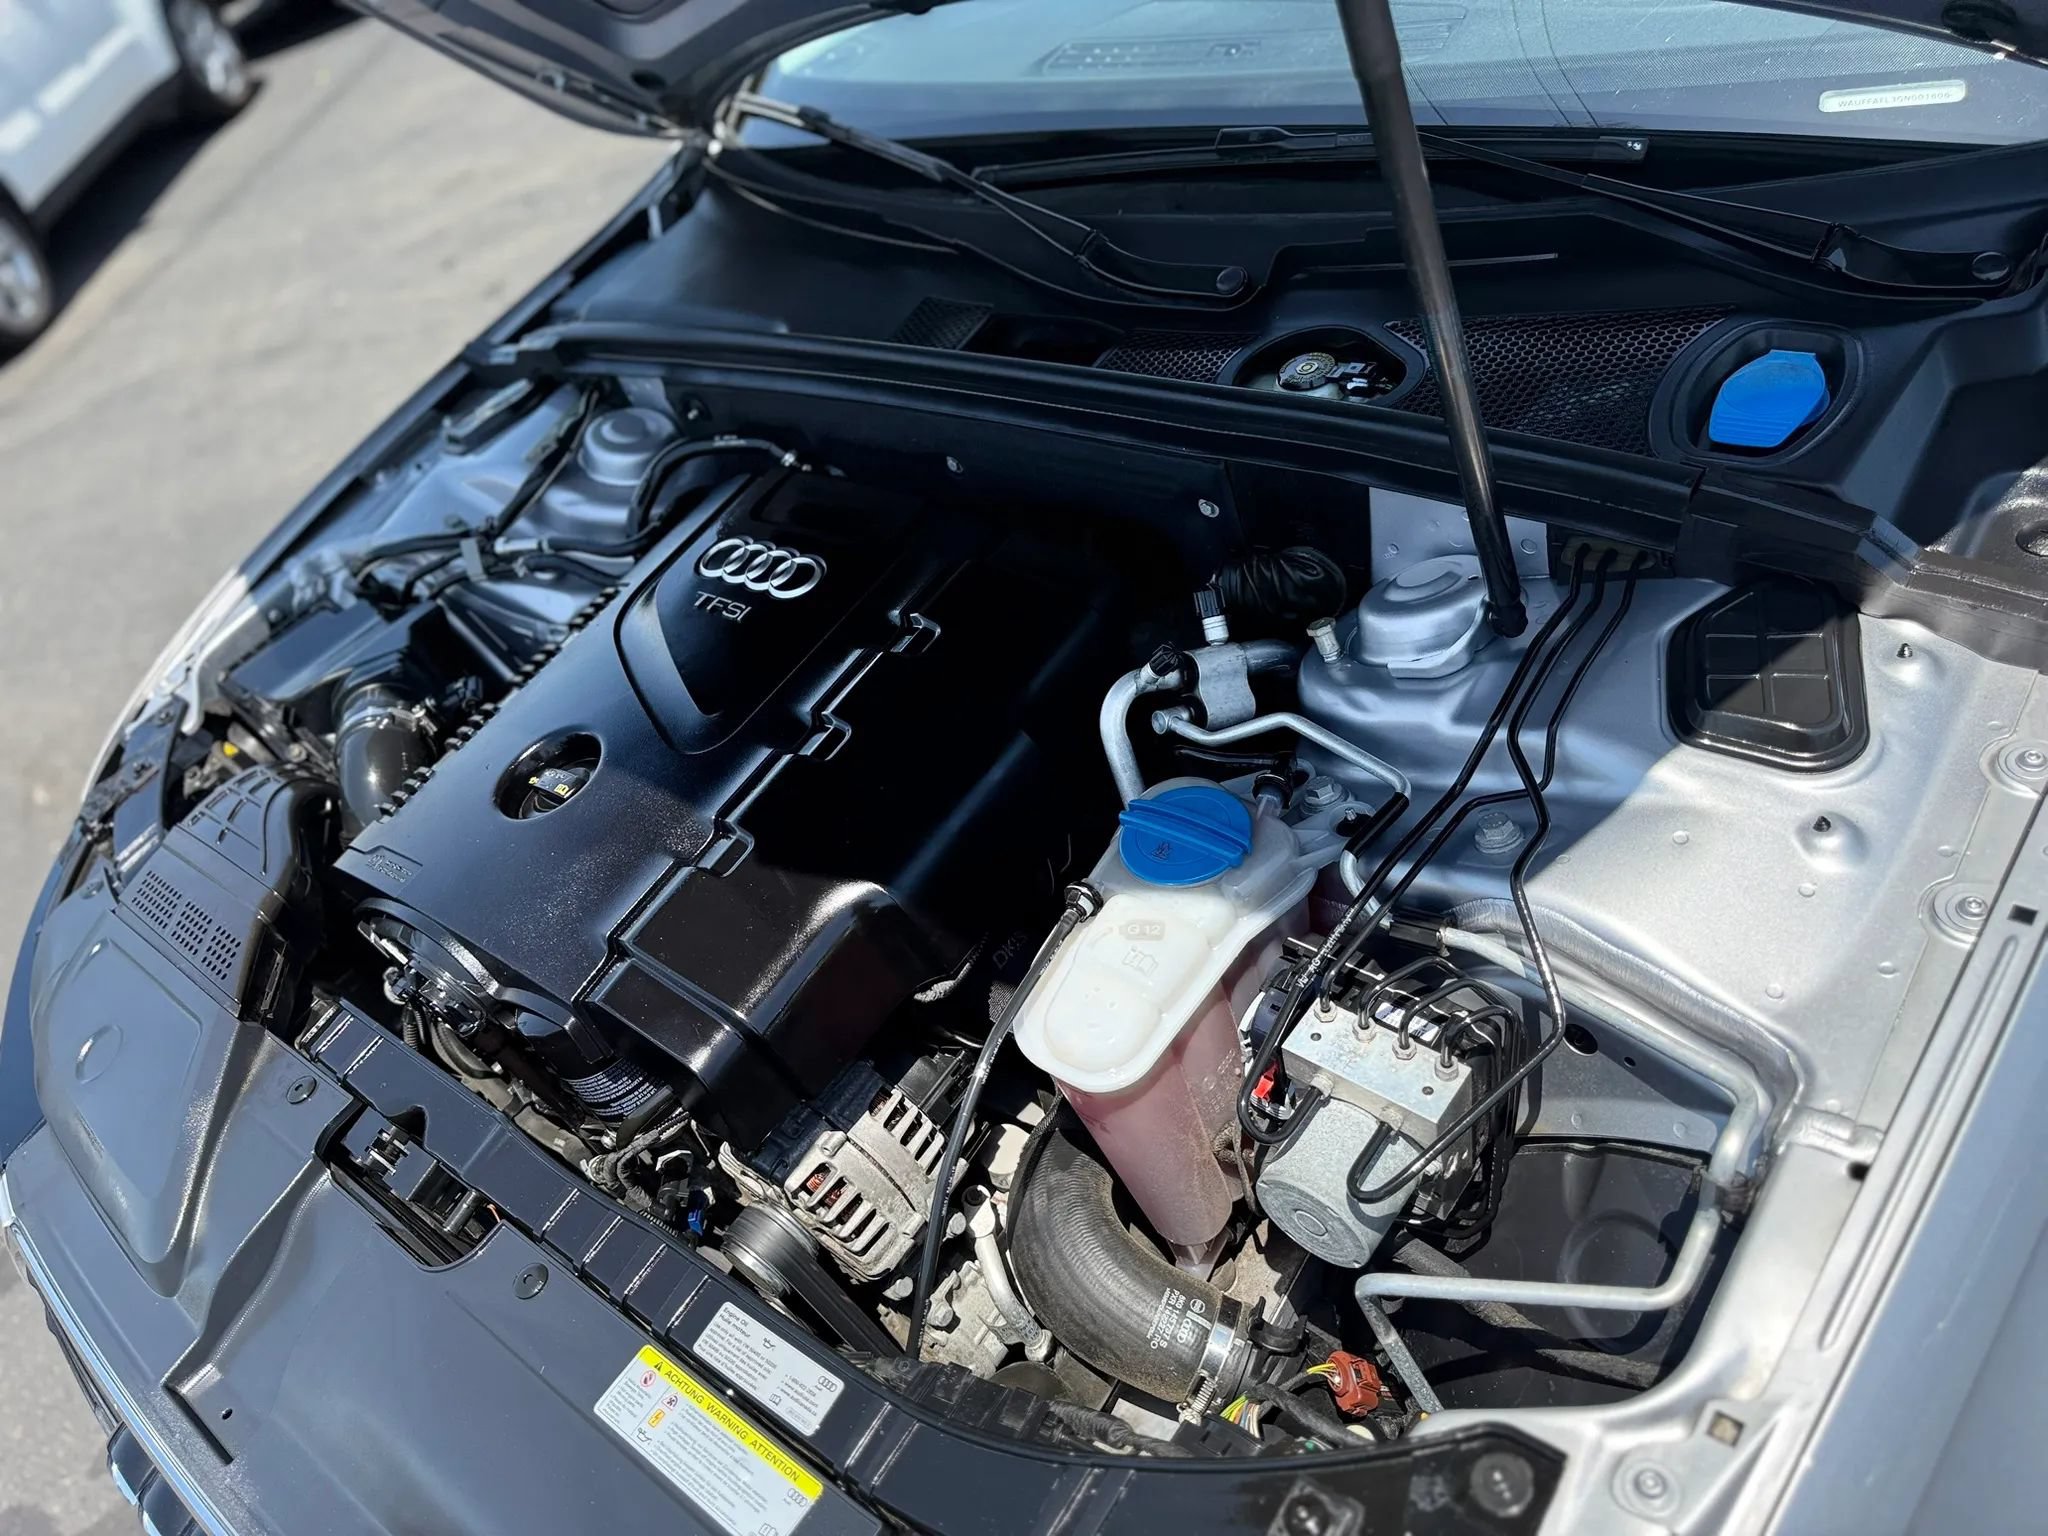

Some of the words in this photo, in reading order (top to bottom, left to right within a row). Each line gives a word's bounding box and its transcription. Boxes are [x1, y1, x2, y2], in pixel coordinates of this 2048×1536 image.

[693, 591, 753, 624] TFSI
[1127, 923, 1140, 935] G
[1143, 924, 1160, 936] 12
[1168, 1289, 1180, 1305] PXR
[722, 1306, 741, 1322] Engine
[739, 1318, 748, 1327] Oil
[731, 1322, 750, 1338] moteur
[1159, 1339, 1168, 1348] S
[664, 1369, 705, 1404] ACHTUNG
[704, 1402, 749, 1441] WARNING
[749, 1438, 801, 1482] ATTENTION
